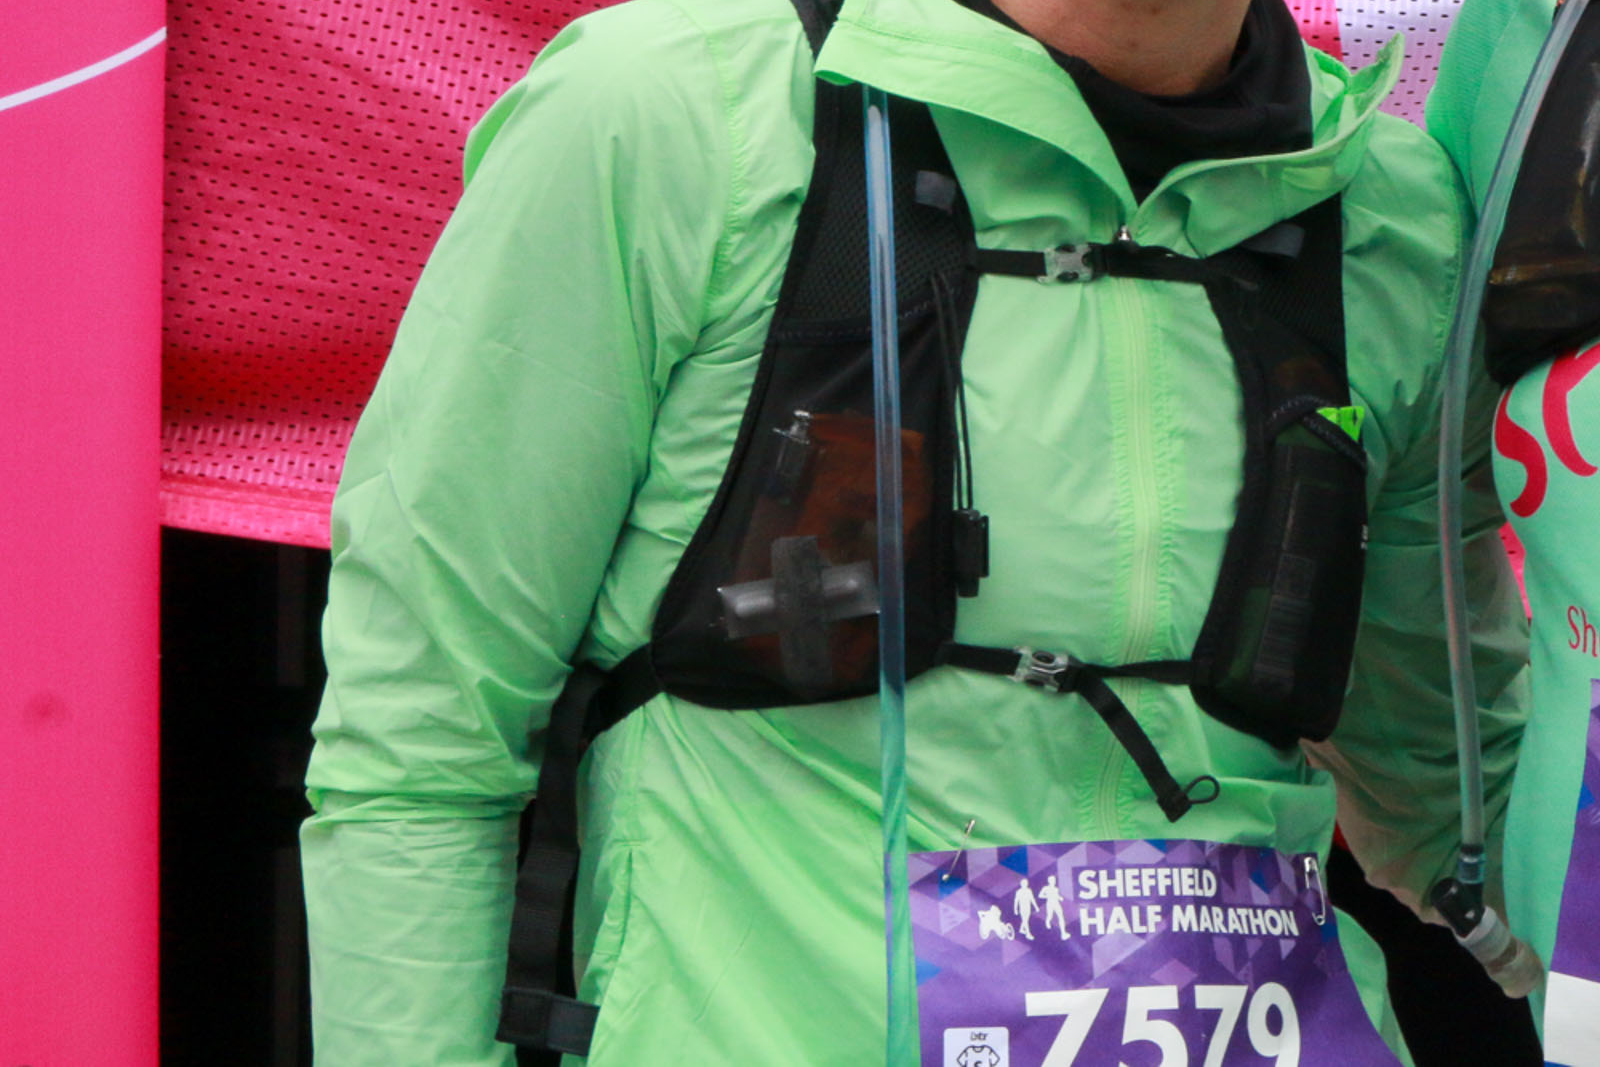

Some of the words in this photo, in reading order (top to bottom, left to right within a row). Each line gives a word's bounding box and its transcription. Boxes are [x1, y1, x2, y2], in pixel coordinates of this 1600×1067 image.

[1078, 867, 1218, 899] SHEFFIELD
[1079, 905, 1163, 936] HALF
[1172, 905, 1300, 937] MARATHON
[1024, 981, 1301, 1067] 7579
